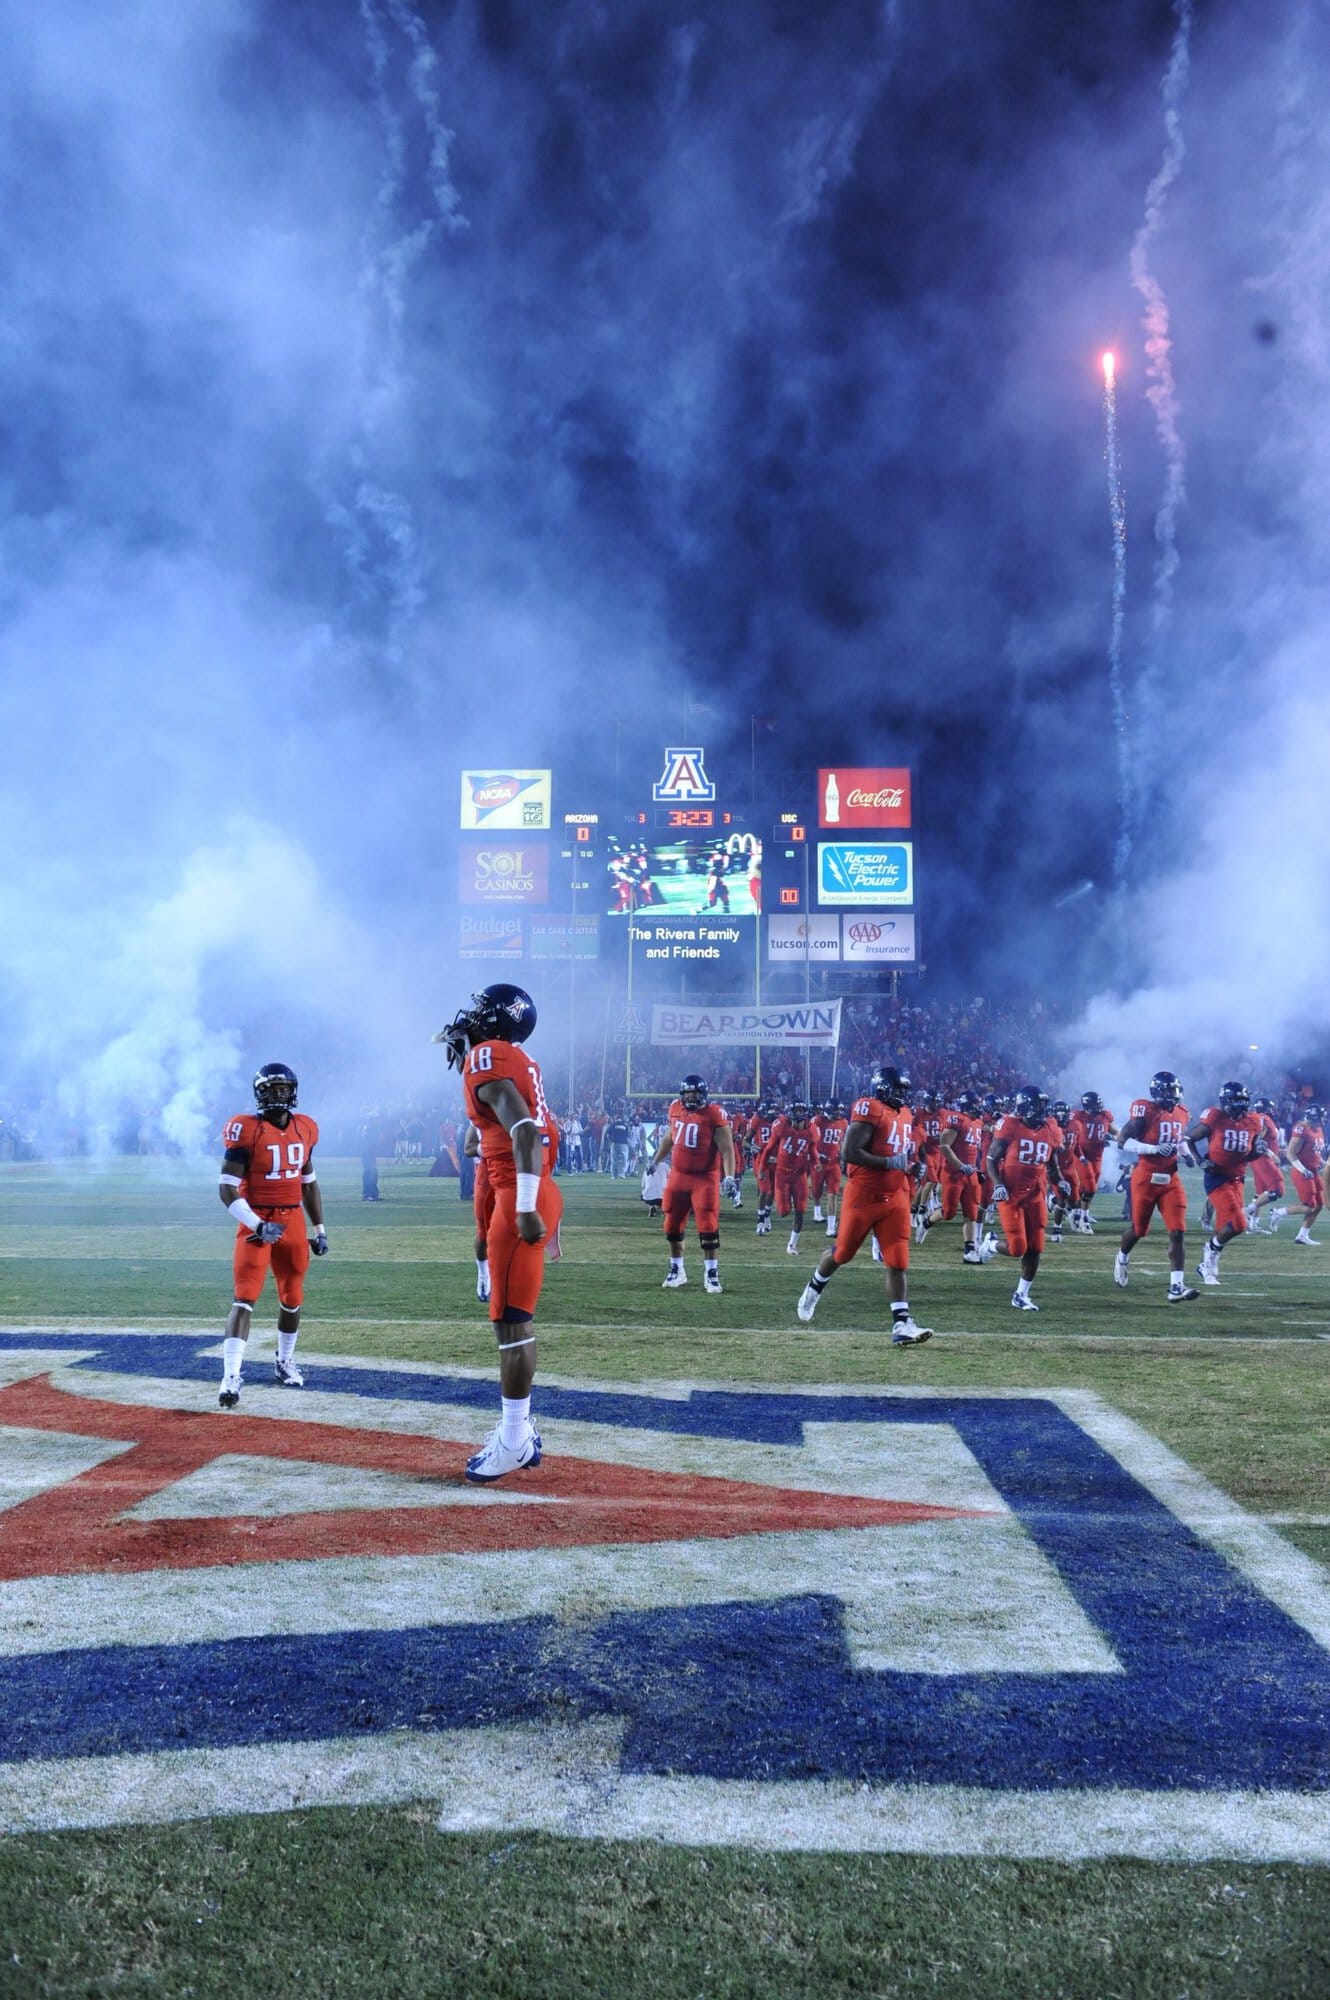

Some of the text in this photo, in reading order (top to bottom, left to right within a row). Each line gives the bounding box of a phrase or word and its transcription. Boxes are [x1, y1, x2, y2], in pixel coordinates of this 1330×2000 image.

[480, 787, 512, 801] NCAA
[565, 814, 598, 824] ARIZONA
[638, 813, 646, 824] 3
[668, 811, 713, 826] 3:23
[723, 813, 731, 824] 3
[781, 814, 798, 823] USC
[475, 851, 533, 879] SOL
[843, 851, 888, 864] Tucson
[848, 863, 900, 875] Electric
[475, 879, 534, 891] CASINOS
[853, 875, 899, 887] Power
[460, 915, 522, 937] Budget
[628, 927, 740, 943] The Rivera Family
[771, 939, 838, 949] tucson.com
[865, 944, 910, 954] Insurance
[646, 946, 720, 958] and Friends
[469, 1046, 493, 1074] 18
[854, 1101, 870, 1116] 46
[946, 1115, 959, 1125] 45
[225, 1122, 243, 1141] 19
[673, 1120, 699, 1149] 70
[823, 1128, 841, 1144] 85
[924, 1120, 940, 1137] 12
[1159, 1121, 1183, 1145] 83
[887, 1120, 912, 1154] 46
[1223, 1129, 1250, 1153] 88
[783, 1136, 807, 1156] 47
[1018, 1138, 1049, 1165] 28
[266, 1142, 304, 1180] 19
